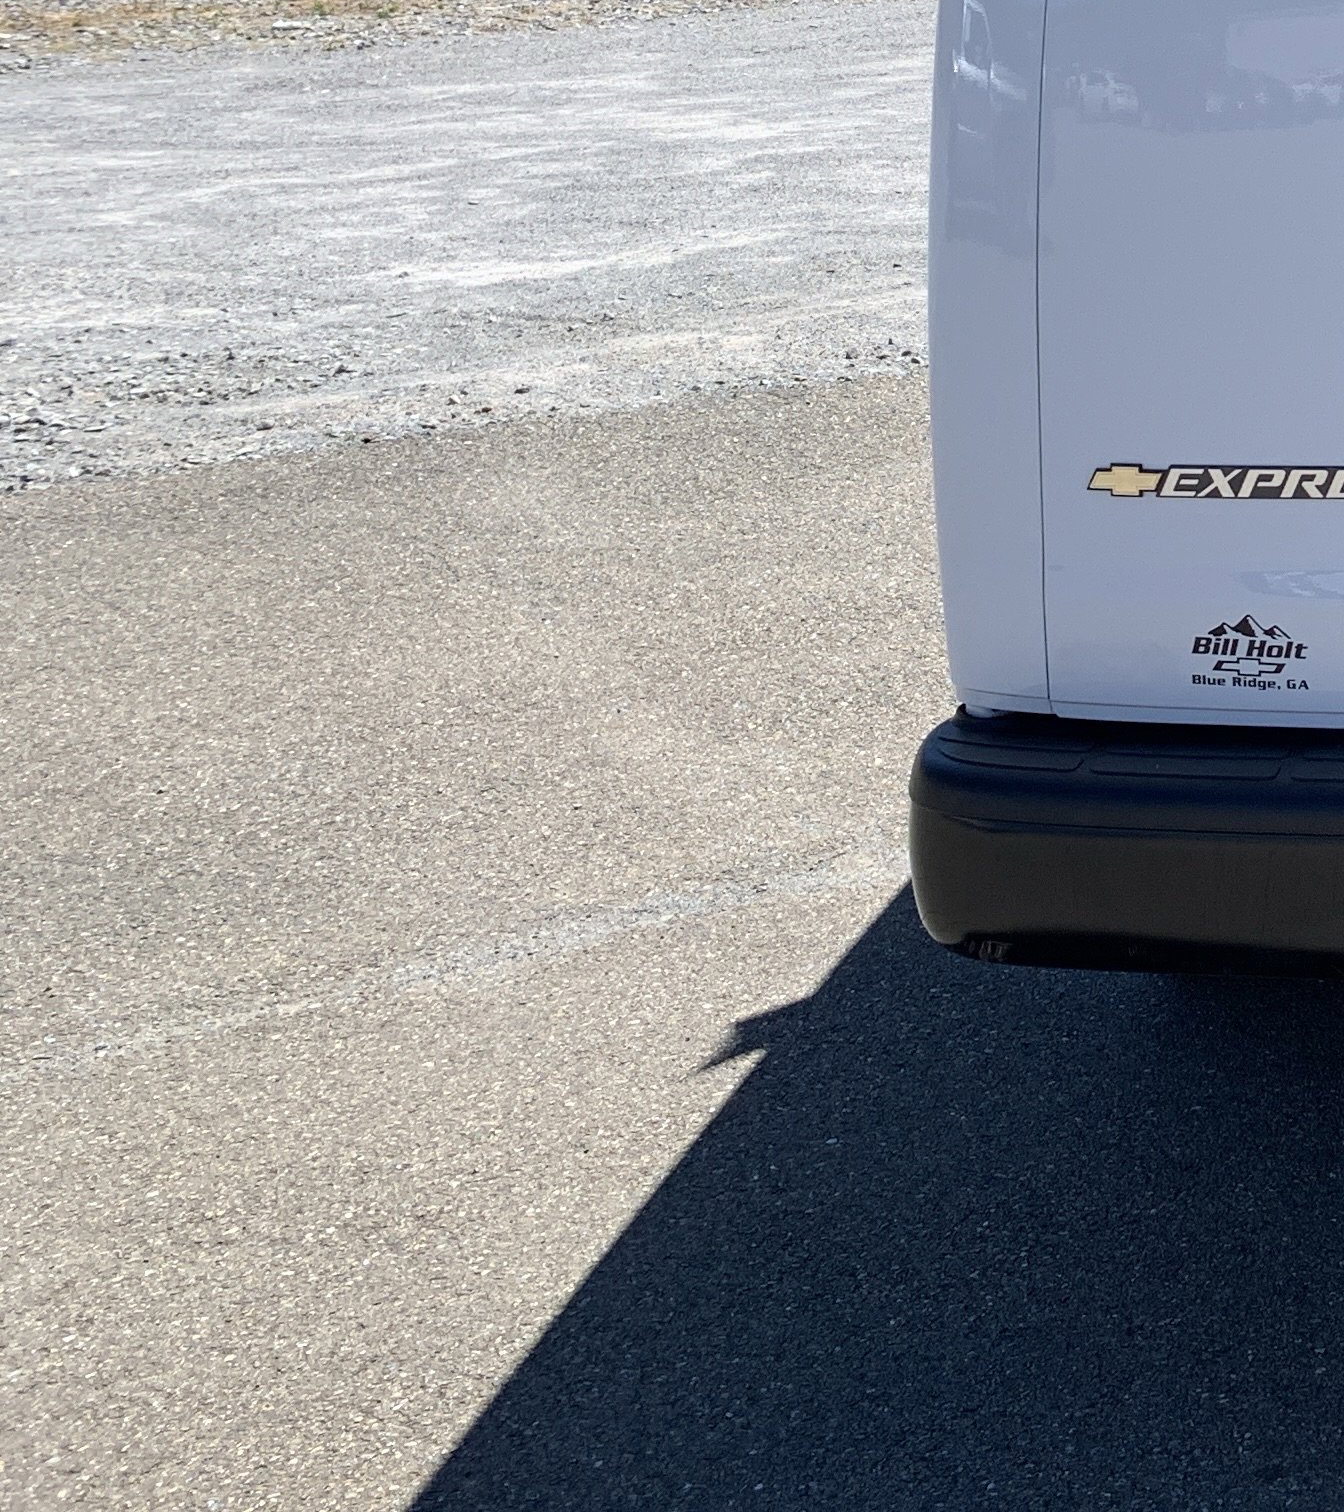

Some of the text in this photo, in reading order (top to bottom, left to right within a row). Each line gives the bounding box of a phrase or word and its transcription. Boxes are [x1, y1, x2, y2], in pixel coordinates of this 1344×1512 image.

[1191, 637, 1309, 659] Bill Holt
[1191, 674, 1310, 690] Blue Ridge, GA
